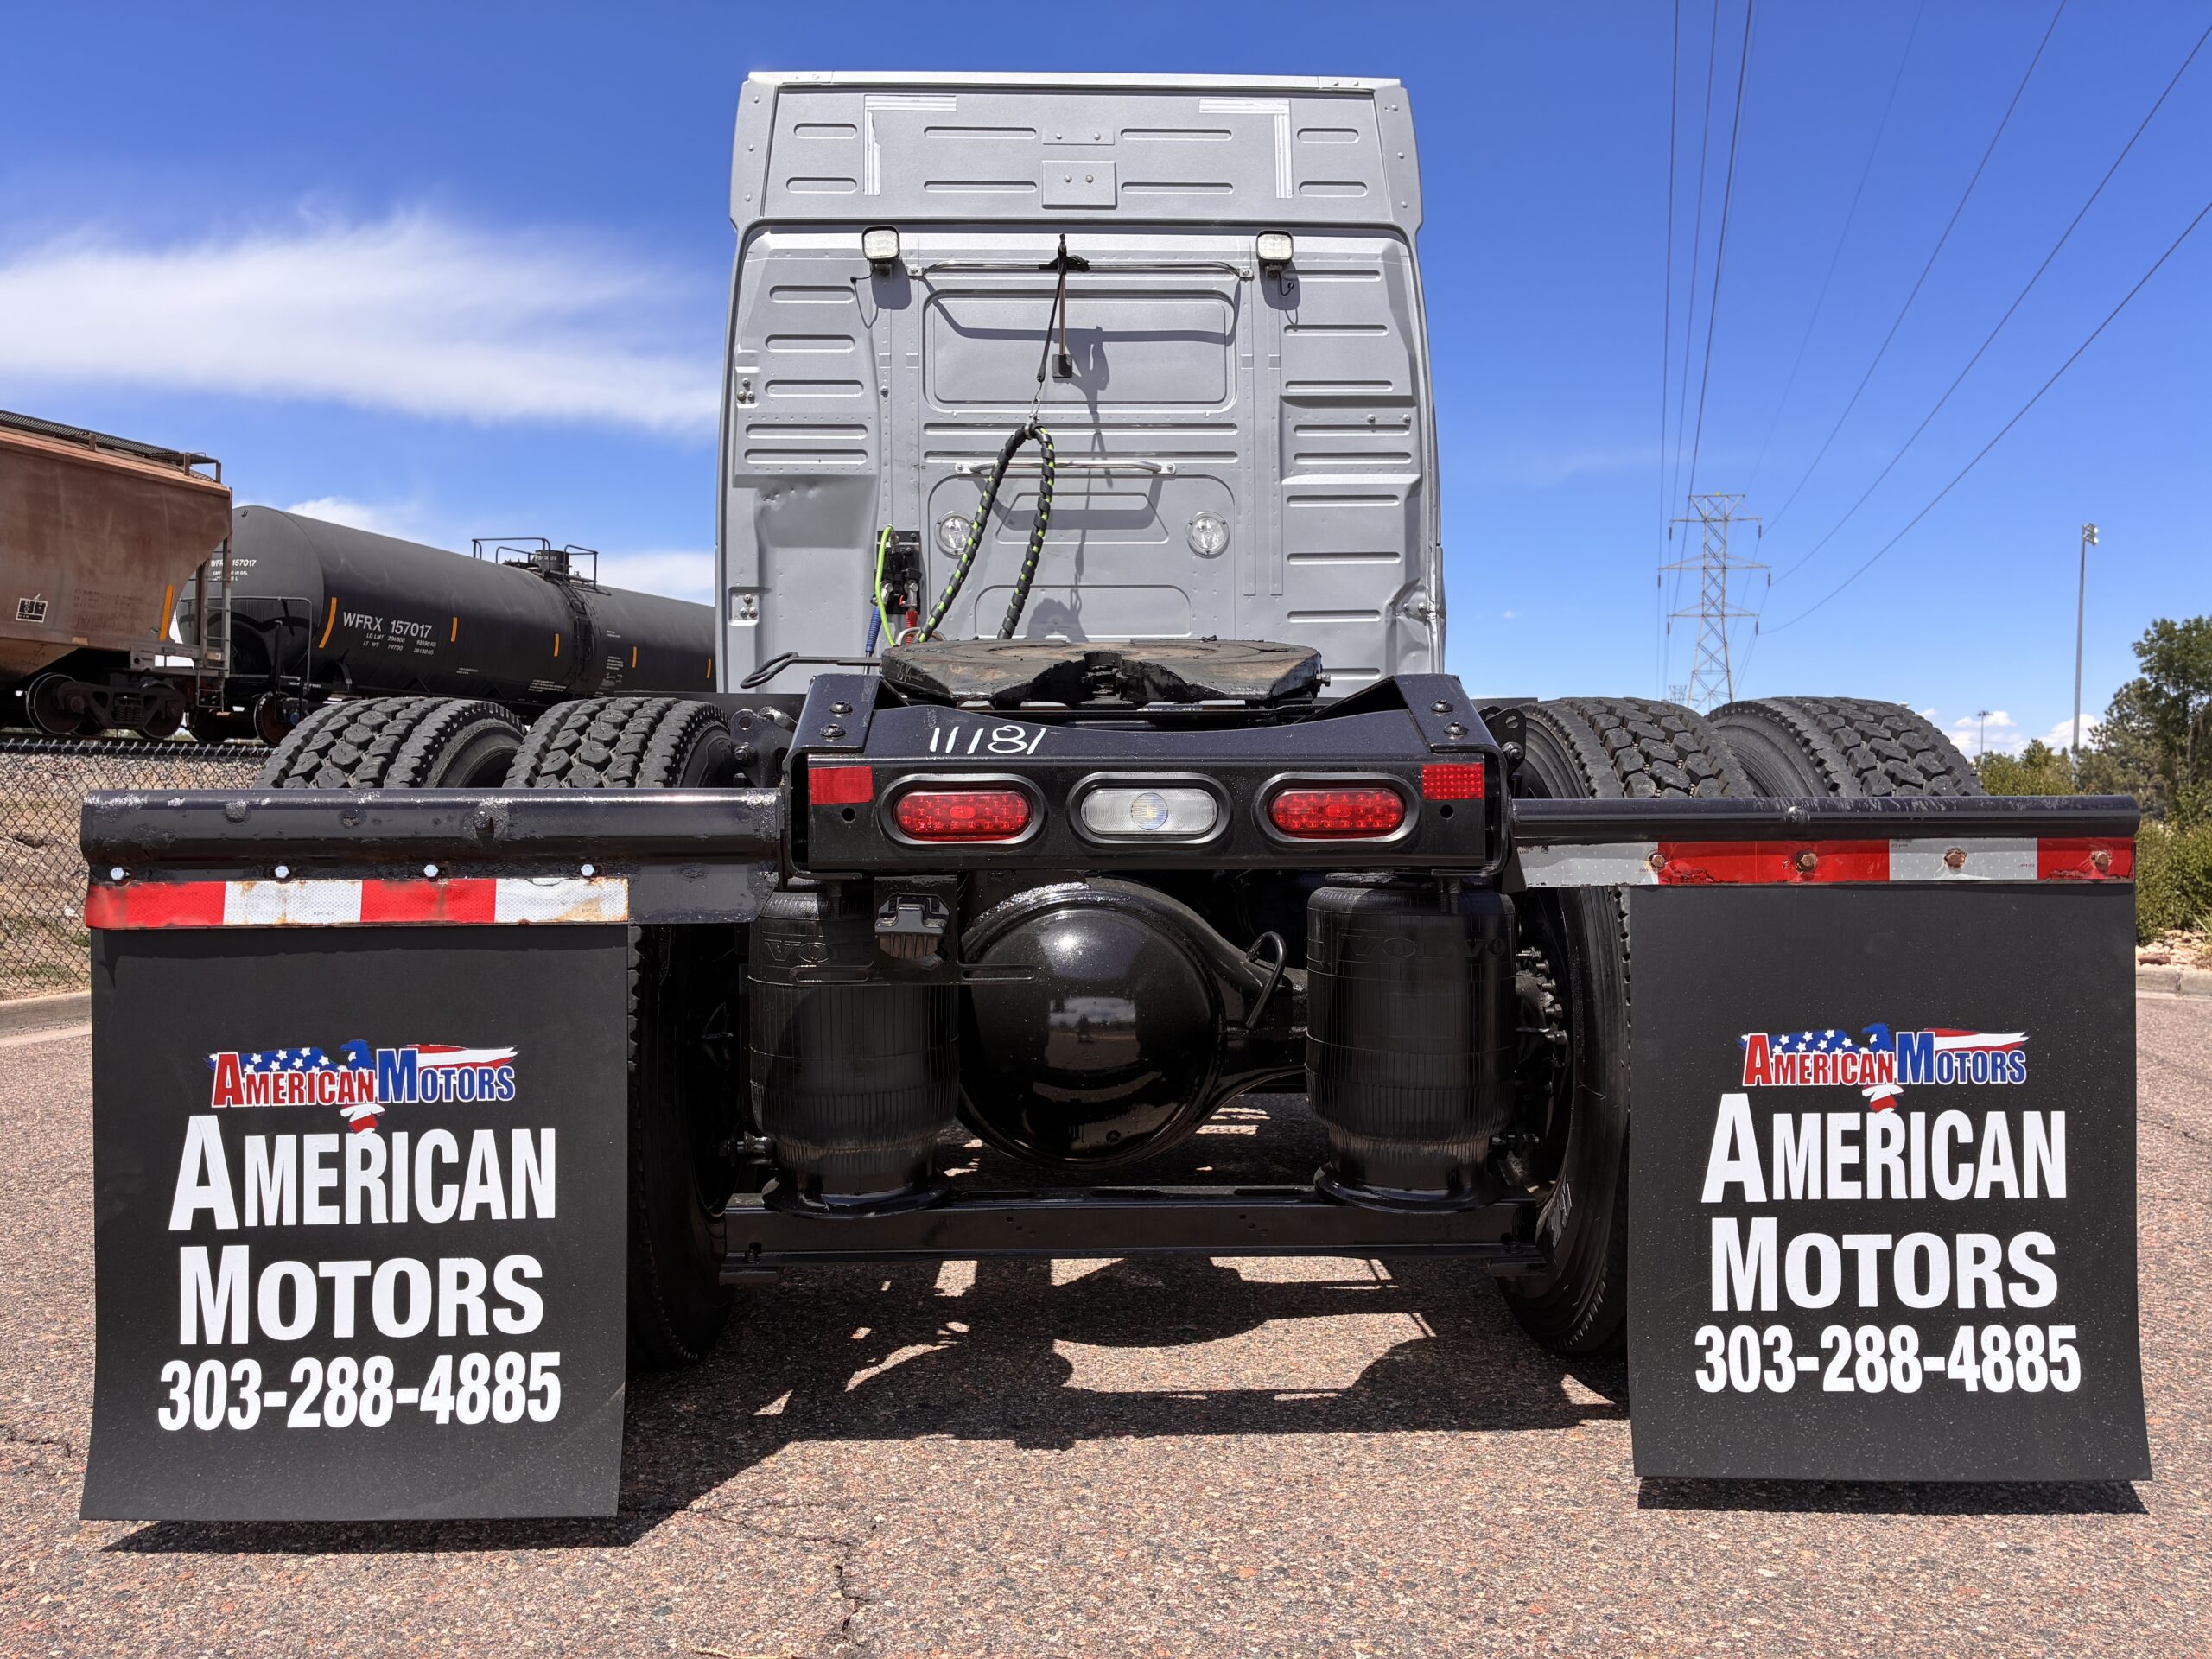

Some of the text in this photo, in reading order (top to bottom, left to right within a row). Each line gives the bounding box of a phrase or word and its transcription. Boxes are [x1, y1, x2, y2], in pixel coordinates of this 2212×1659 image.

[343, 612, 432, 638] WFRX 157017
[212, 1048, 516, 1108] AMERICAN MOTORS
[1743, 1032, 2027, 1086] AMERICAN MOTORS
[168, 1115, 556, 1231] AMERICAN
[1701, 1093, 2067, 1204] AMERICAN
[180, 1245, 544, 1345] MOTORS
[1712, 1217, 2058, 1311] MOTORS
[158, 1351, 562, 1432] 303-288-4885
[1695, 1325, 2082, 1394] 303-288-4885
